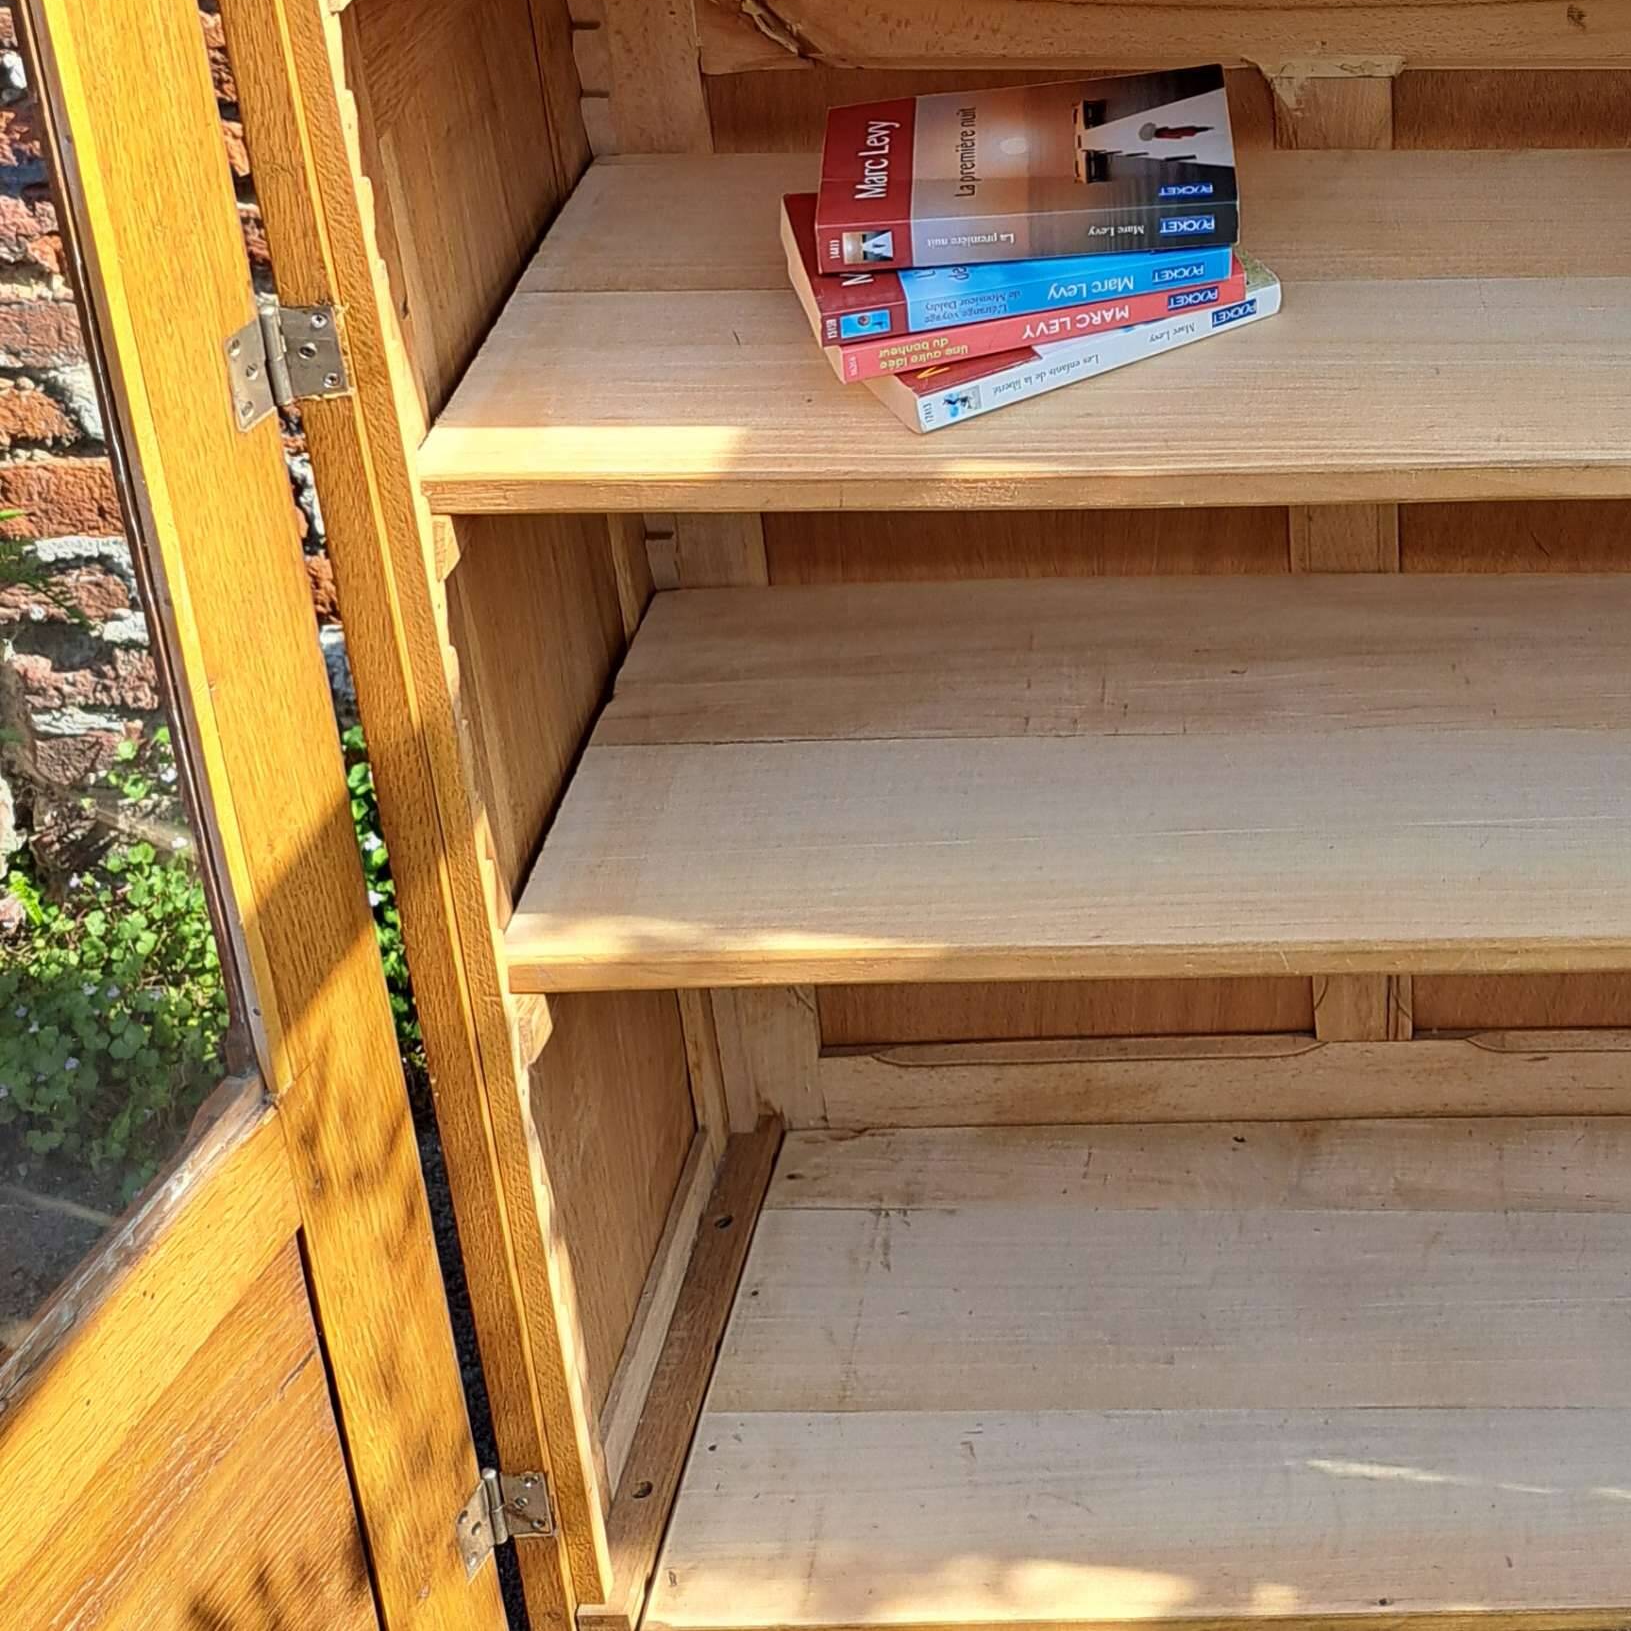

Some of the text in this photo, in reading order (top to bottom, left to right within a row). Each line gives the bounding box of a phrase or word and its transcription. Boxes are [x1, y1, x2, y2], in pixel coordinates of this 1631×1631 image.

[854, 120, 900, 200] Marc Levy
[955, 107, 983, 198] La première nuit
[1087, 224, 1145, 237] Marc Levy
[1159, 216, 1215, 233] POCKET
[927, 232, 1015, 249] La première nuit
[1151, 264, 1205, 283] POCKET
[1047, 275, 1134, 301] Marc Levy
[1167, 287, 1219, 309] POCKET
[1021, 305, 1130, 340] MARC LEVY
[1211, 301, 1257, 326] POCKET
[1148, 322, 1196, 345] Marc Levy
[877, 337, 949, 359] du bonheur
